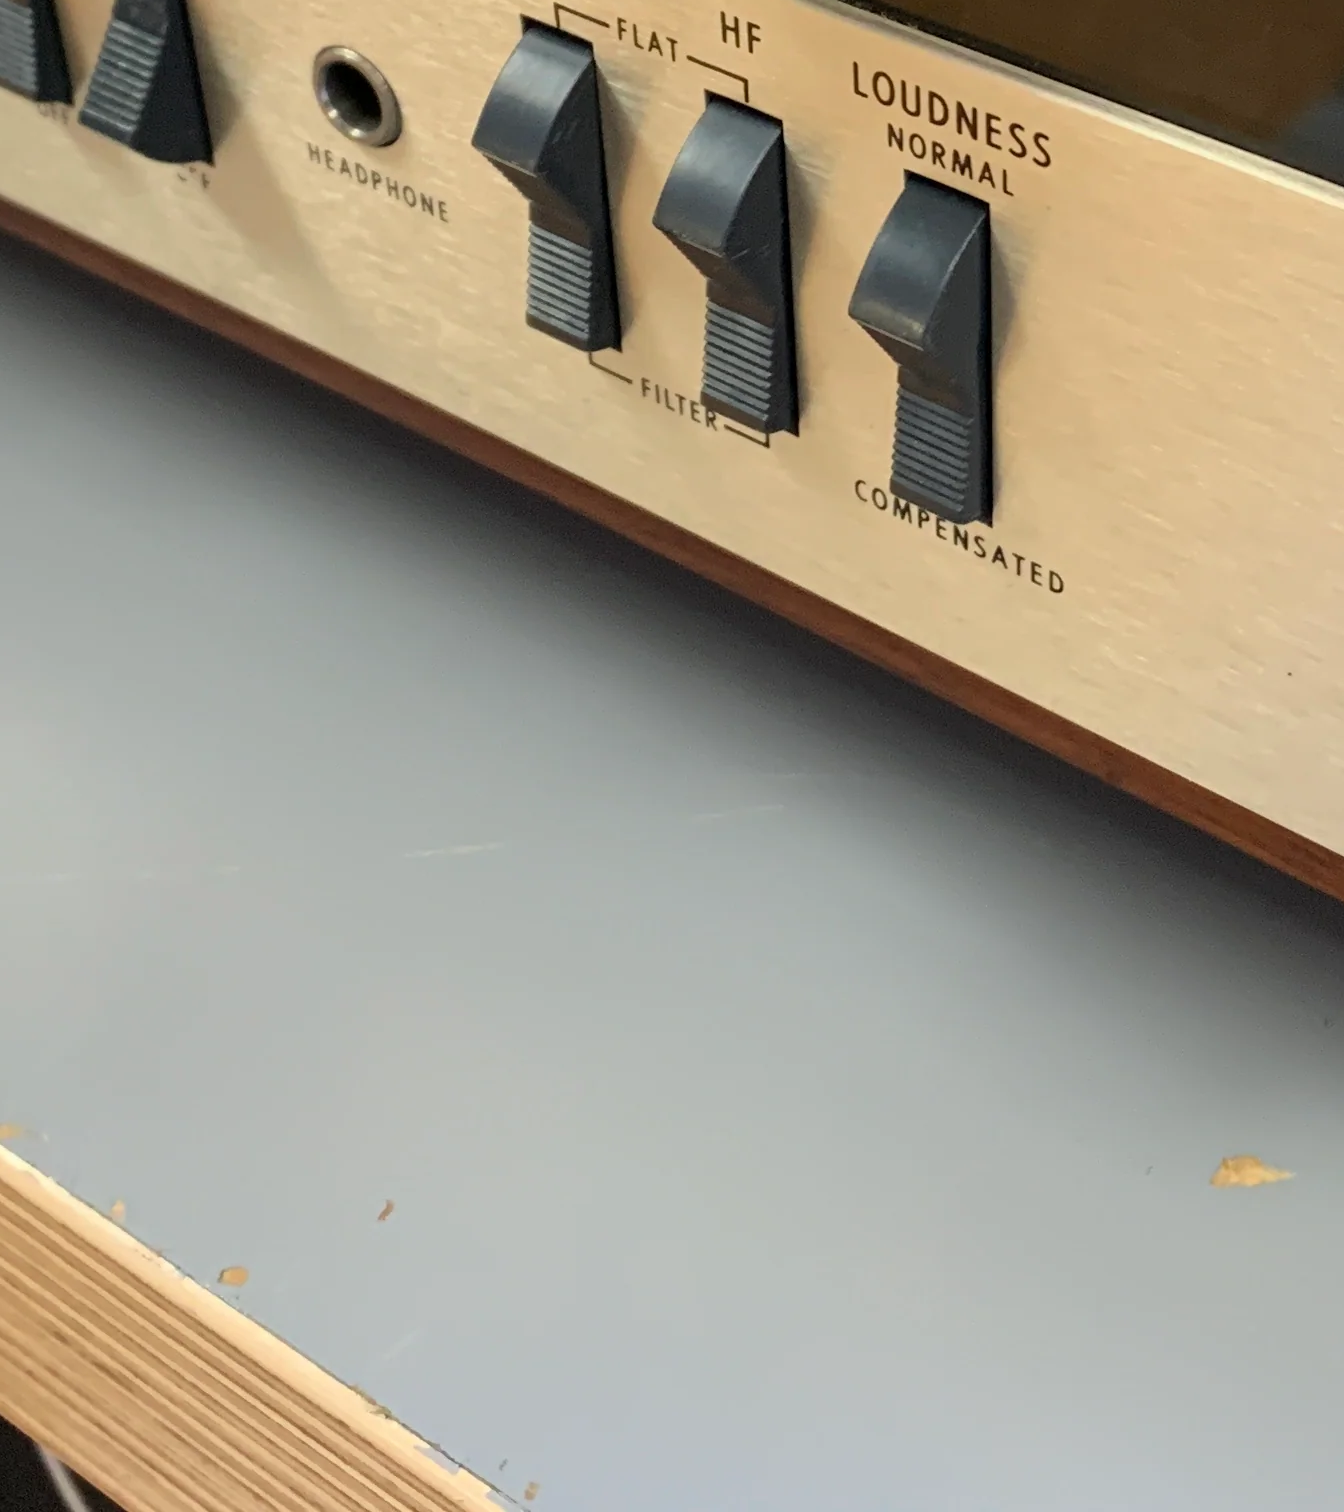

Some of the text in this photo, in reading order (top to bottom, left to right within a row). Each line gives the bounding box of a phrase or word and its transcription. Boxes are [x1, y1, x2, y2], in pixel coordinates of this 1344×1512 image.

[616, 17, 679, 63] FLAT
[719, 10, 762, 54] HF
[851, 61, 1053, 169] LOUDNESS
[306, 141, 450, 224] HEADPHONE
[886, 122, 1015, 197] NORMAL
[640, 377, 719, 432] FILTER
[853, 478, 1065, 595] COMPENSATED
